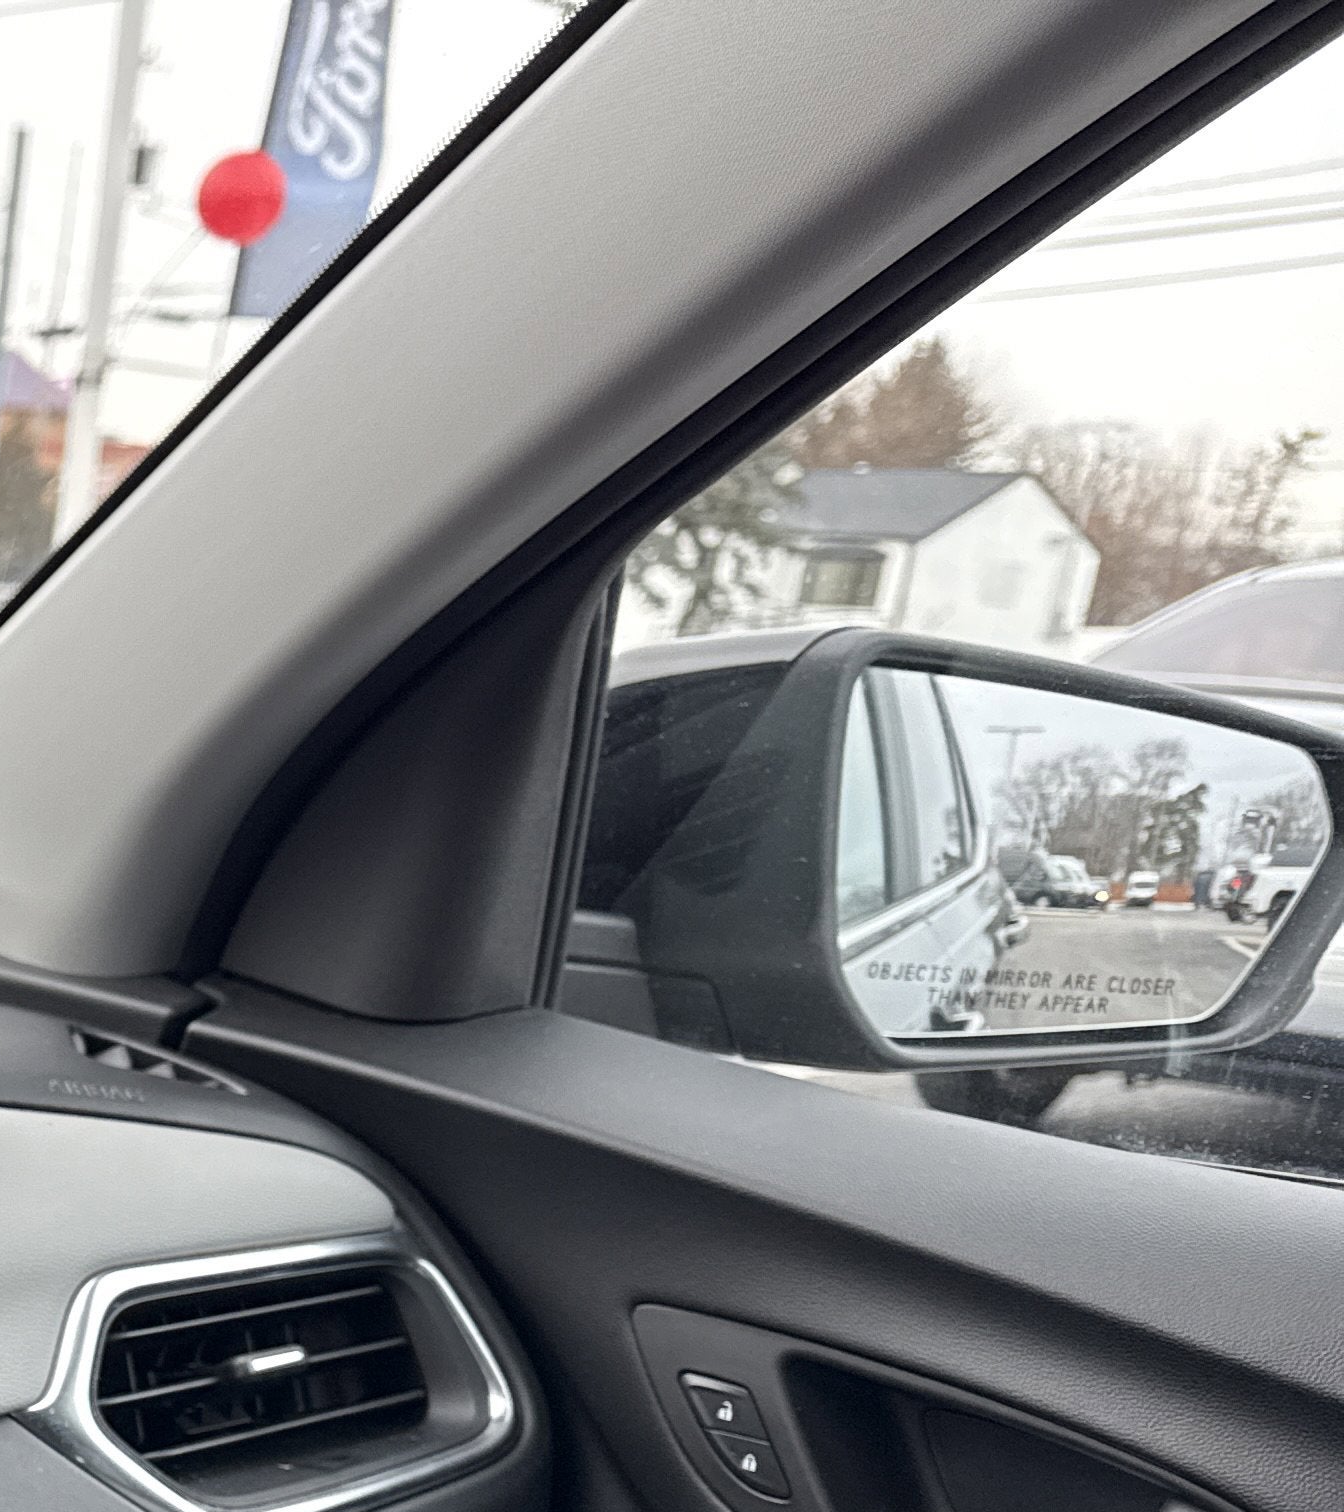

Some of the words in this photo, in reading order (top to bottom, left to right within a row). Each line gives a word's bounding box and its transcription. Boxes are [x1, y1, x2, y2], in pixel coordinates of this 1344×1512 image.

[288, 0, 388, 180] For
[867, 960, 953, 984] OBJECTS
[959, 967, 977, 985] IN
[985, 969, 1053, 989] MIRROR
[1062, 973, 1098, 991] ARE
[1107, 975, 1176, 995] CLOSER
[927, 986, 979, 1011] THAN
[983, 990, 1031, 1010] THEY
[1038, 994, 1110, 1014] APPEAR
